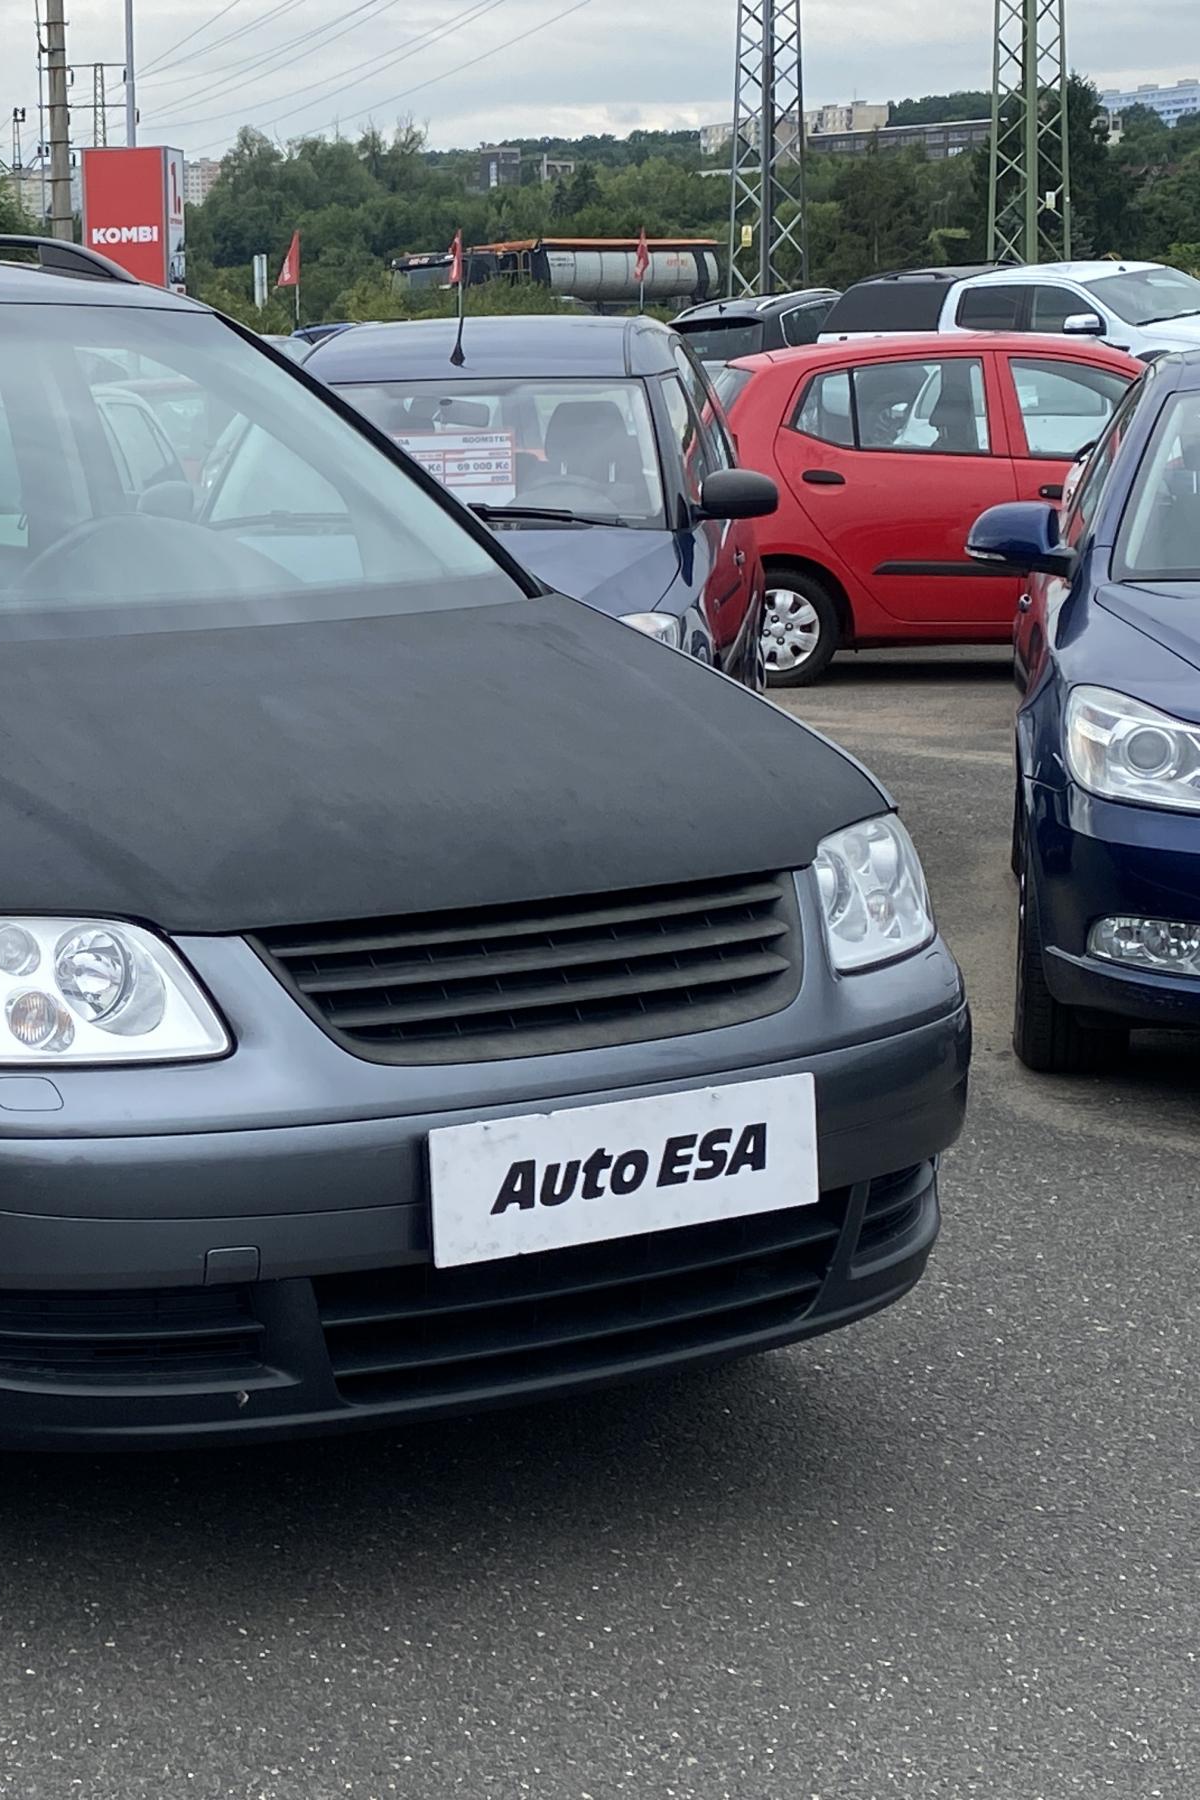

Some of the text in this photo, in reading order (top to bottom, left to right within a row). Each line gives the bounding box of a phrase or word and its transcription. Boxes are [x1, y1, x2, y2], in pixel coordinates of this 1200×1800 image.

[92, 226, 159, 244] KOMBI
[490, 1122, 767, 1215] Auto ESA
